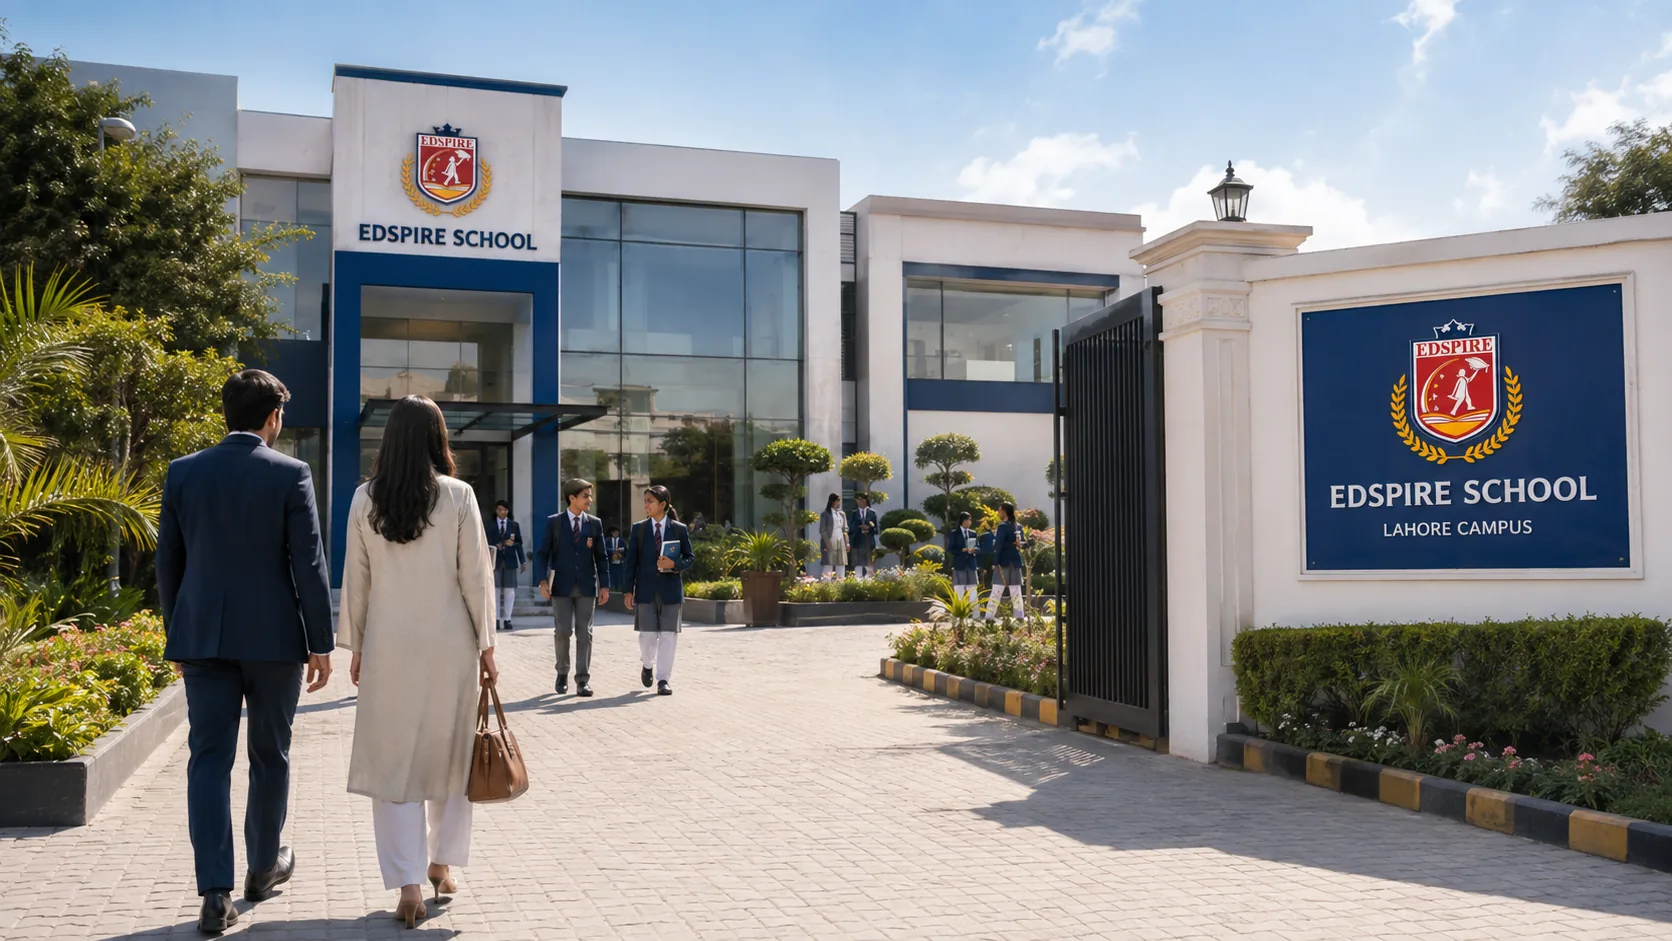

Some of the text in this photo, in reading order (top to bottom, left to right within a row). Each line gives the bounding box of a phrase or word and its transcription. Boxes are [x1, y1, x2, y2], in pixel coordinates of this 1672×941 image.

[420, 136, 474, 148] EDSPIRE
[359, 223, 537, 250] EDSPIRE SCHOOL
[1416, 337, 1493, 357] EDSPIRE
[1330, 476, 1597, 508] EDSPIRE SCHOOL
[1384, 520, 1533, 537] LAHORE CAMPUS
